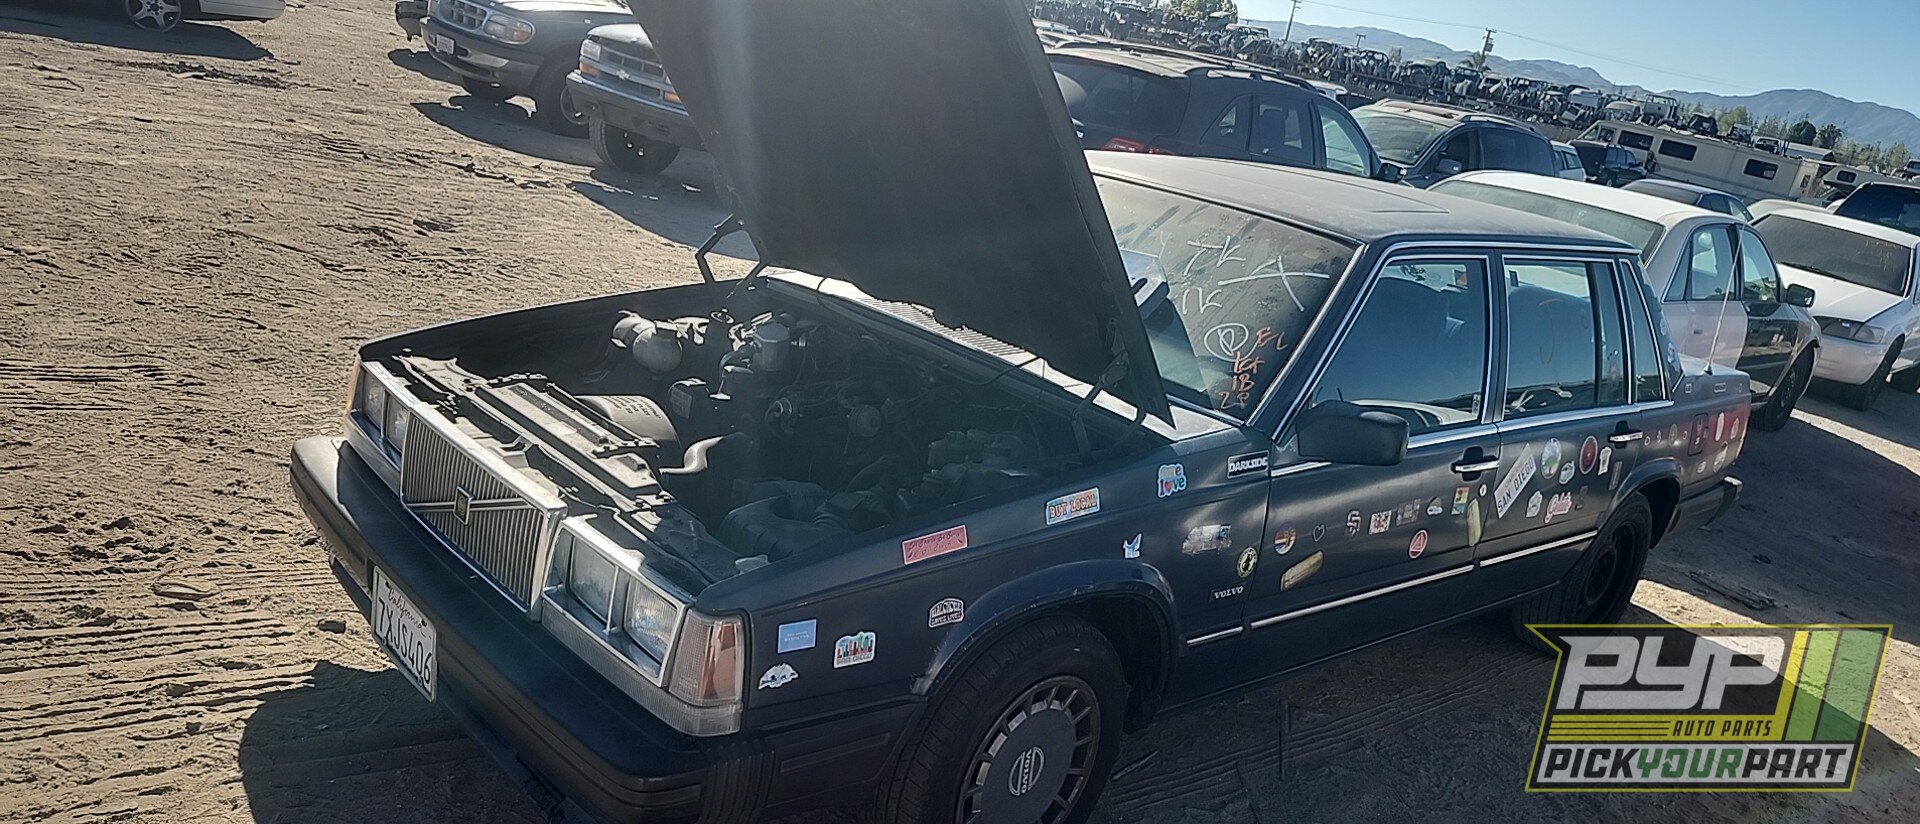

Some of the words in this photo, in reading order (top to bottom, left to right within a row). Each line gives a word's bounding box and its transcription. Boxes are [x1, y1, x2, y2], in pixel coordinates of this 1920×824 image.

[1228, 457, 1268, 473] DARKSIDE
[1049, 502, 1068, 519] BUY
[1070, 494, 1098, 513] LOCAL
[1214, 586, 1244, 599] VOLVO
[378, 597, 432, 685] 7XJS406
[1021, 748, 1032, 794] VOLVO
